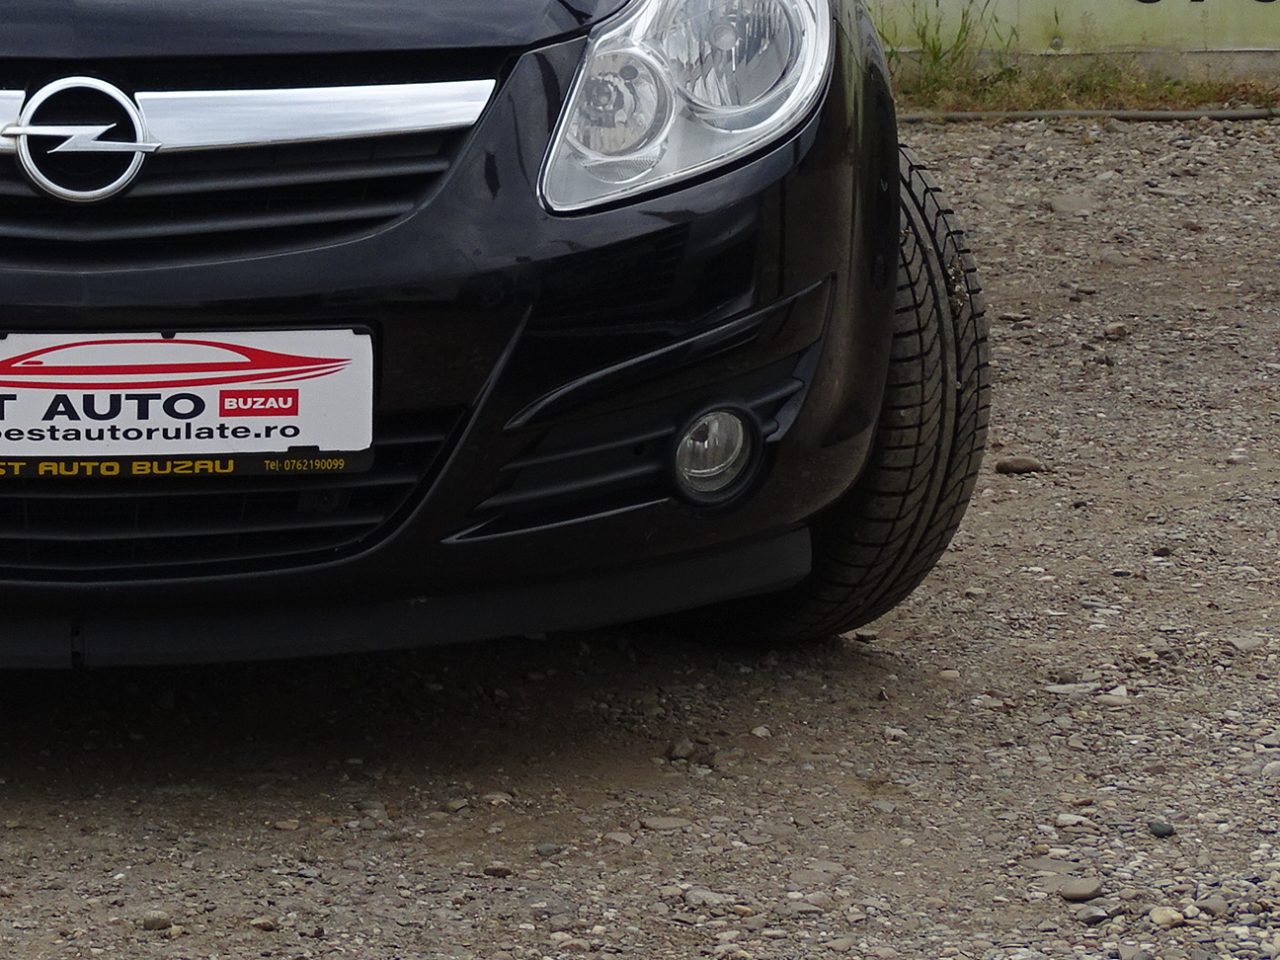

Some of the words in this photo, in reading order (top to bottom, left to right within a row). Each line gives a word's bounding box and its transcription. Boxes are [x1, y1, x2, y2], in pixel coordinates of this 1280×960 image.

[41, 392, 206, 421] AUTO
[224, 397, 293, 410] BUZAU
[37, 460, 120, 476] AUTO
[131, 458, 235, 475] BUZAU
[284, 458, 345, 471] 0762190099
